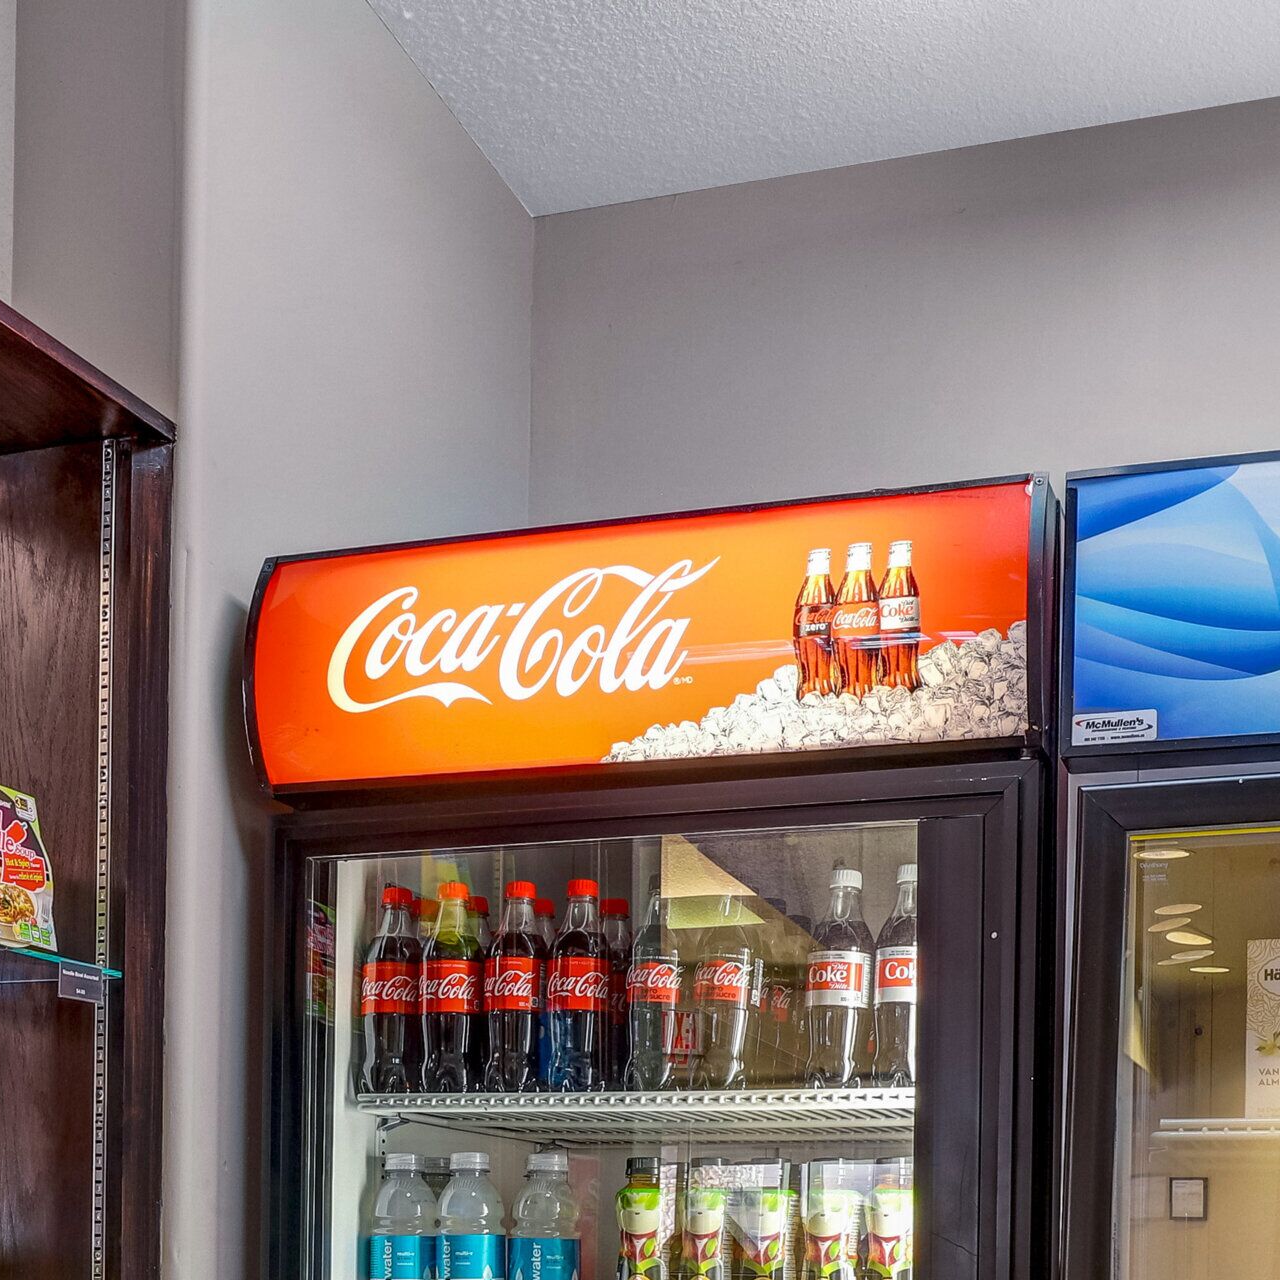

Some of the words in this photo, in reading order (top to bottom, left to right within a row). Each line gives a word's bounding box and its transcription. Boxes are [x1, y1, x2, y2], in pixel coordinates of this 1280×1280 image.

[328, 554, 721, 712] Coca-Cola
[1085, 718, 1144, 729] McMullen's
[15, 843, 36, 859] Soup
[547, 971, 611, 1001] Coca-Cola
[625, 963, 682, 990] Coca-Cola
[808, 966, 847, 984] Coke
